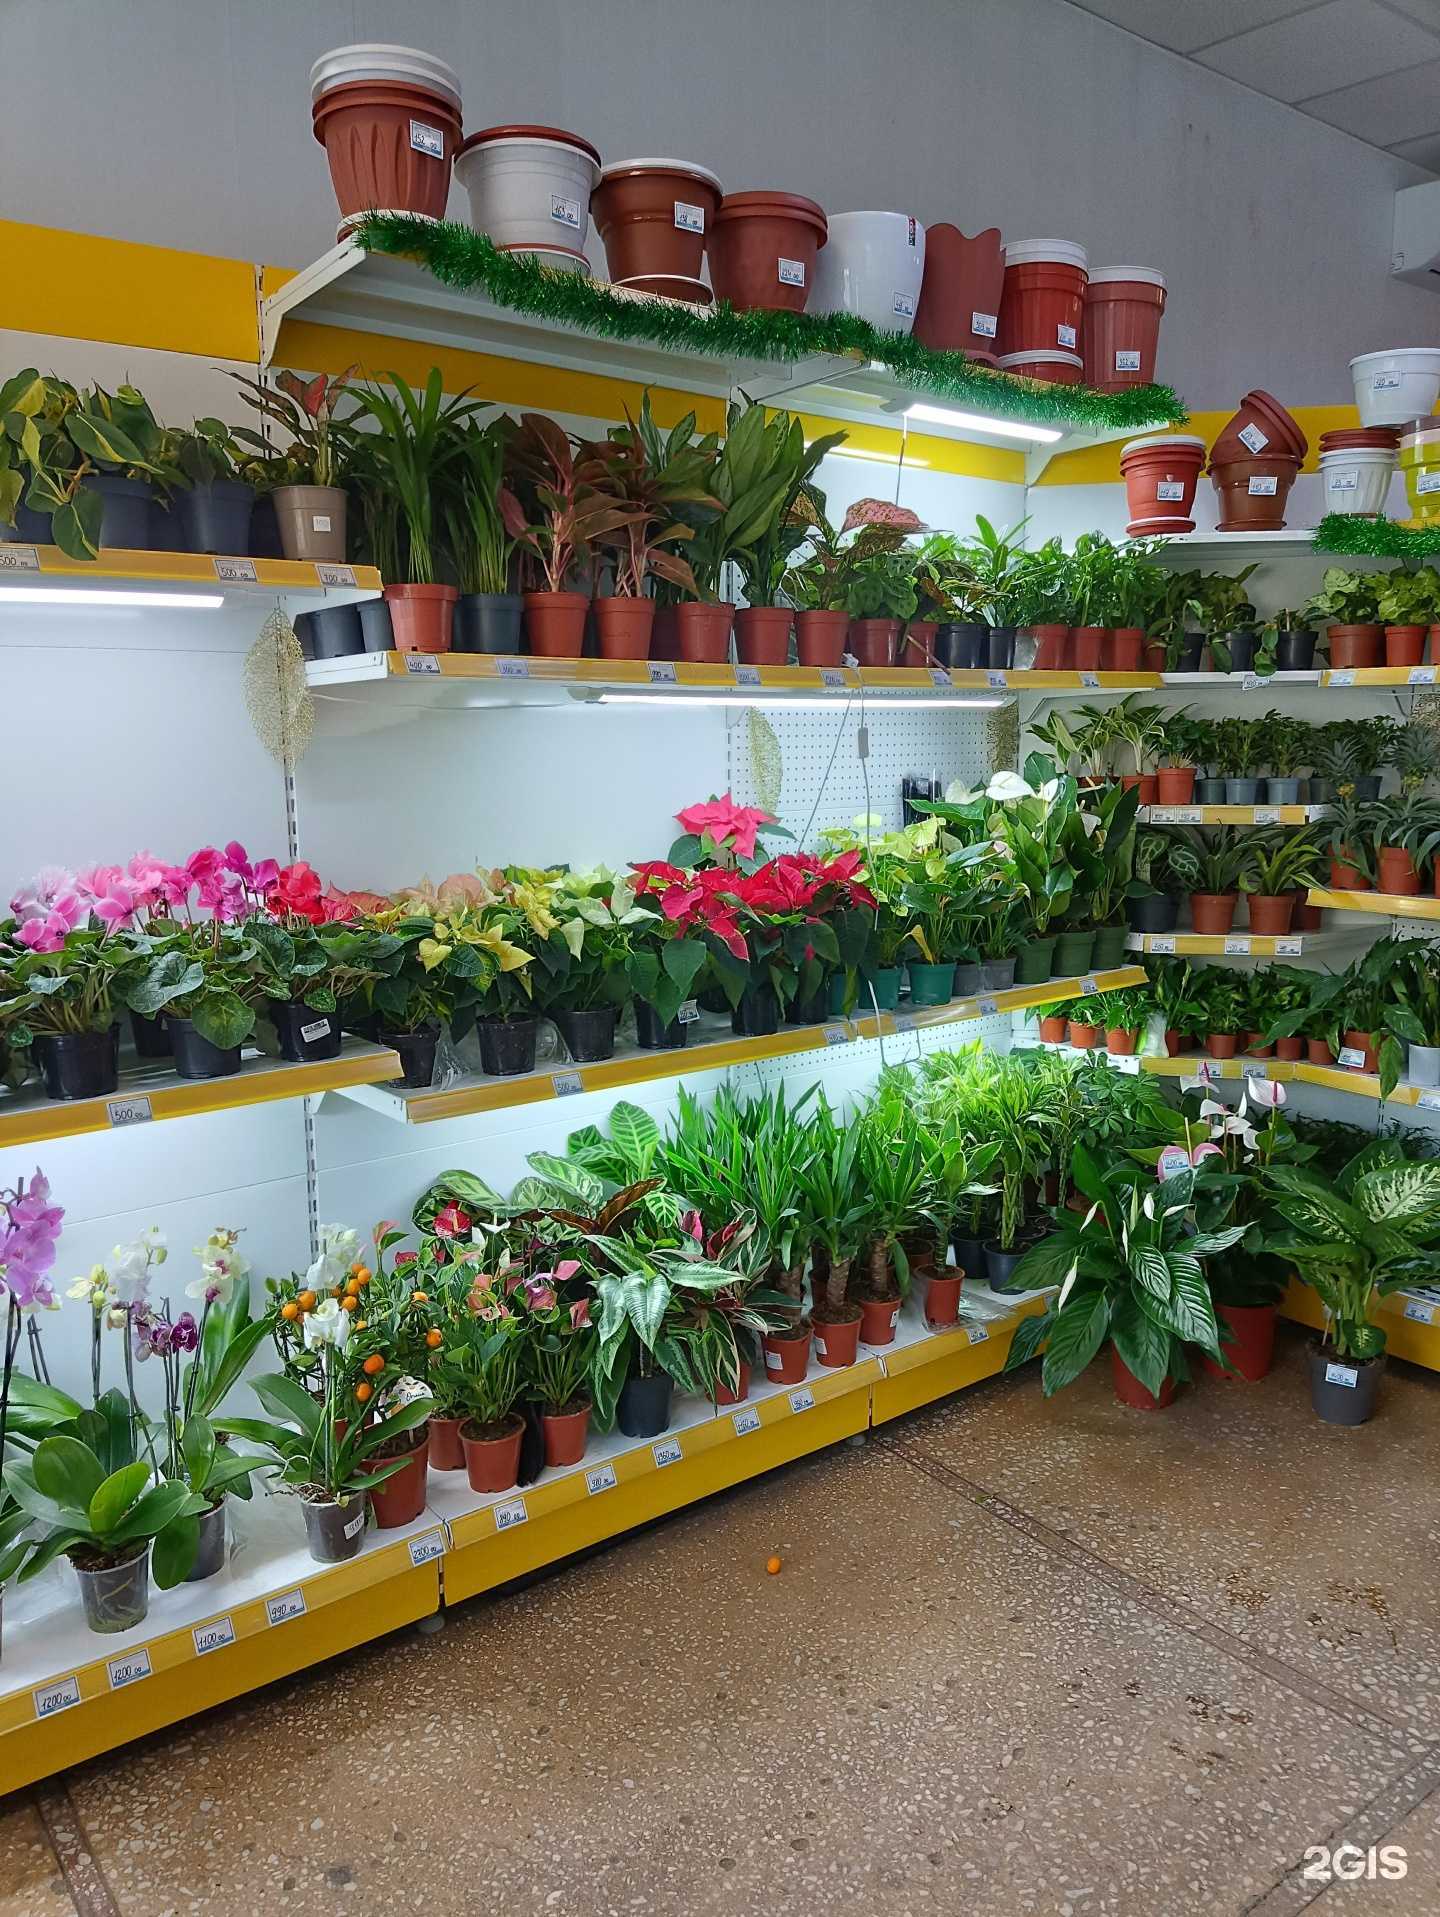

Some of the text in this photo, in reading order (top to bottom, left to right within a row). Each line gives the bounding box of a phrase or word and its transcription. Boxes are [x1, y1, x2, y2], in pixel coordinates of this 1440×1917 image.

[114, 1108, 133, 1121] 500
[271, 1604, 287, 1618] 990
[198, 1632, 217, 1648] 1100
[113, 1666, 132, 1682] 1200
[42, 1692, 62, 1710] 1200
